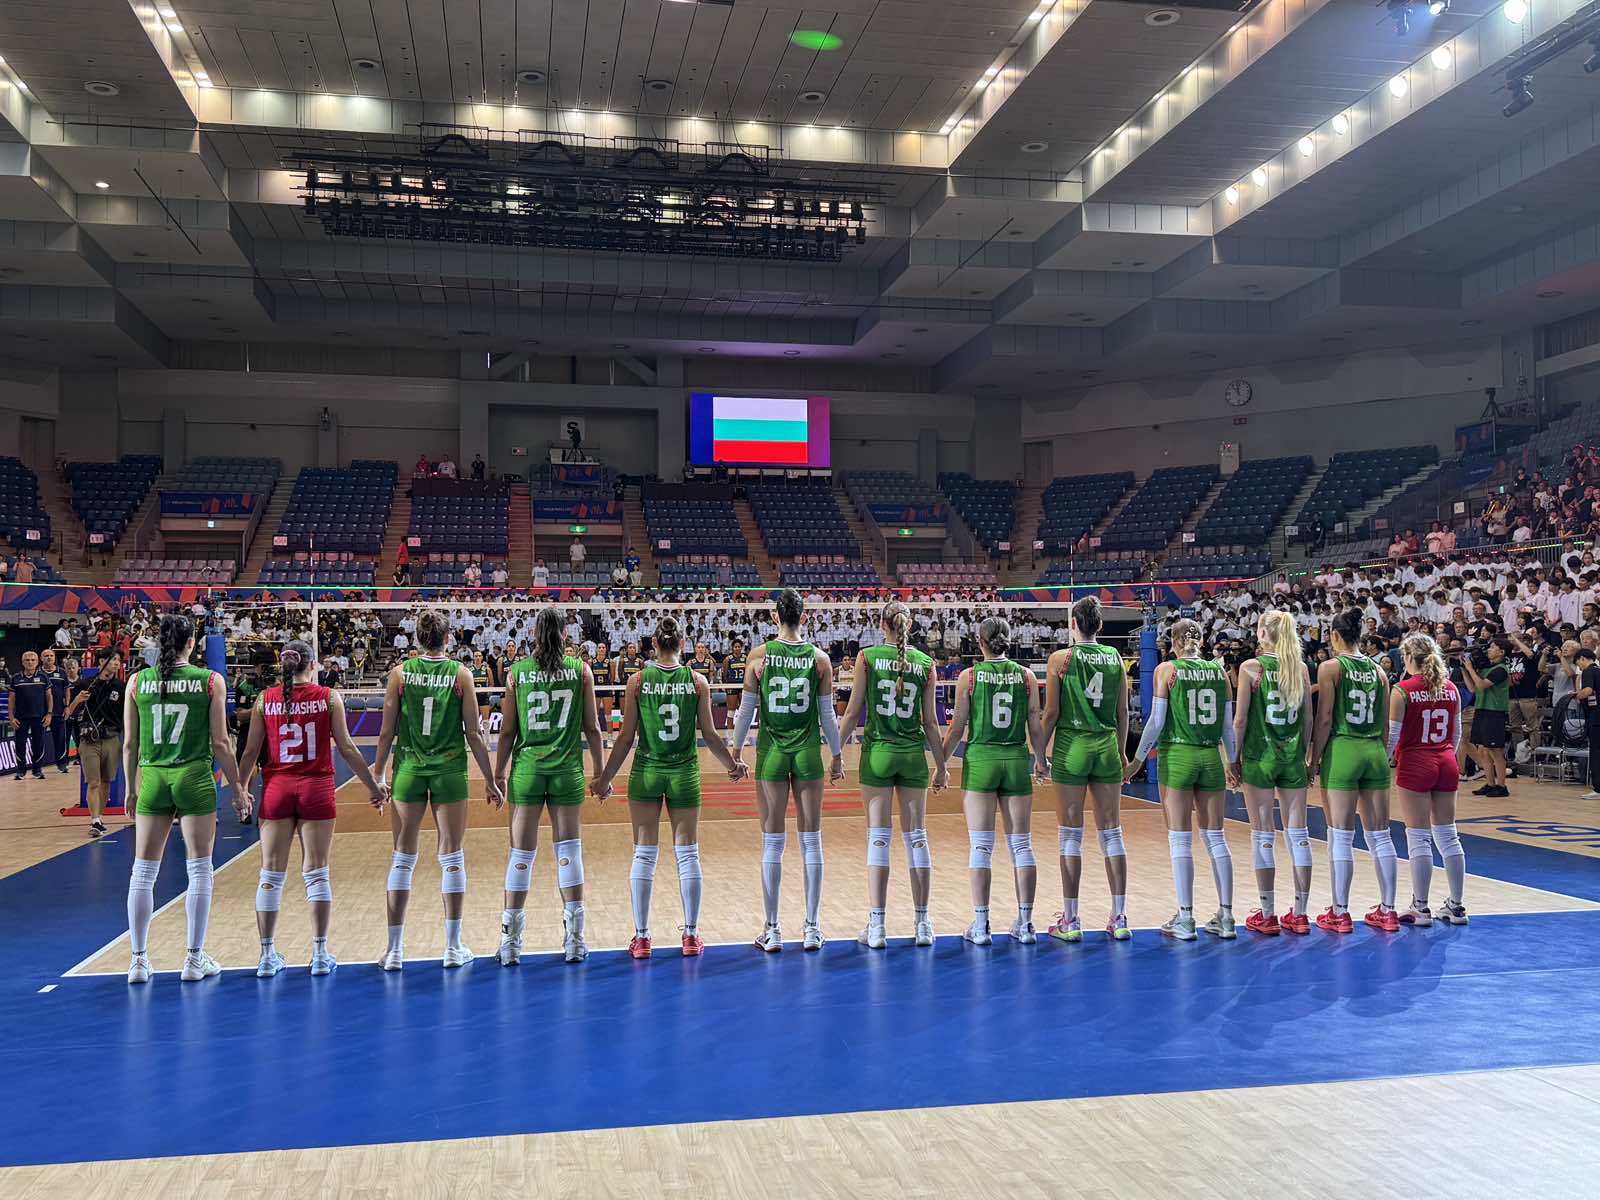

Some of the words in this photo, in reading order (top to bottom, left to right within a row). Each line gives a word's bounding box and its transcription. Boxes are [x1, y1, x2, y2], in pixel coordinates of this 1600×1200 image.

[875, 658, 923, 676] NIKOOVA
[977, 671, 1023, 684] GUNCHEVA
[642, 682, 696, 695] SLAVCHEVA
[768, 677, 810, 713] 23
[876, 680, 917, 718] 33
[1084, 672, 1104, 707] 4
[1345, 689, 1376, 724] 31
[1410, 689, 1456, 703] PASHULEVA
[151, 704, 189, 744] 17
[422, 697, 434, 735] 1
[527, 689, 574, 730] 27
[658, 703, 680, 741] 3
[992, 692, 1013, 728] 6
[1187, 689, 1217, 725] 19
[279, 722, 316, 763] 21
[1422, 708, 1449, 744] 13
